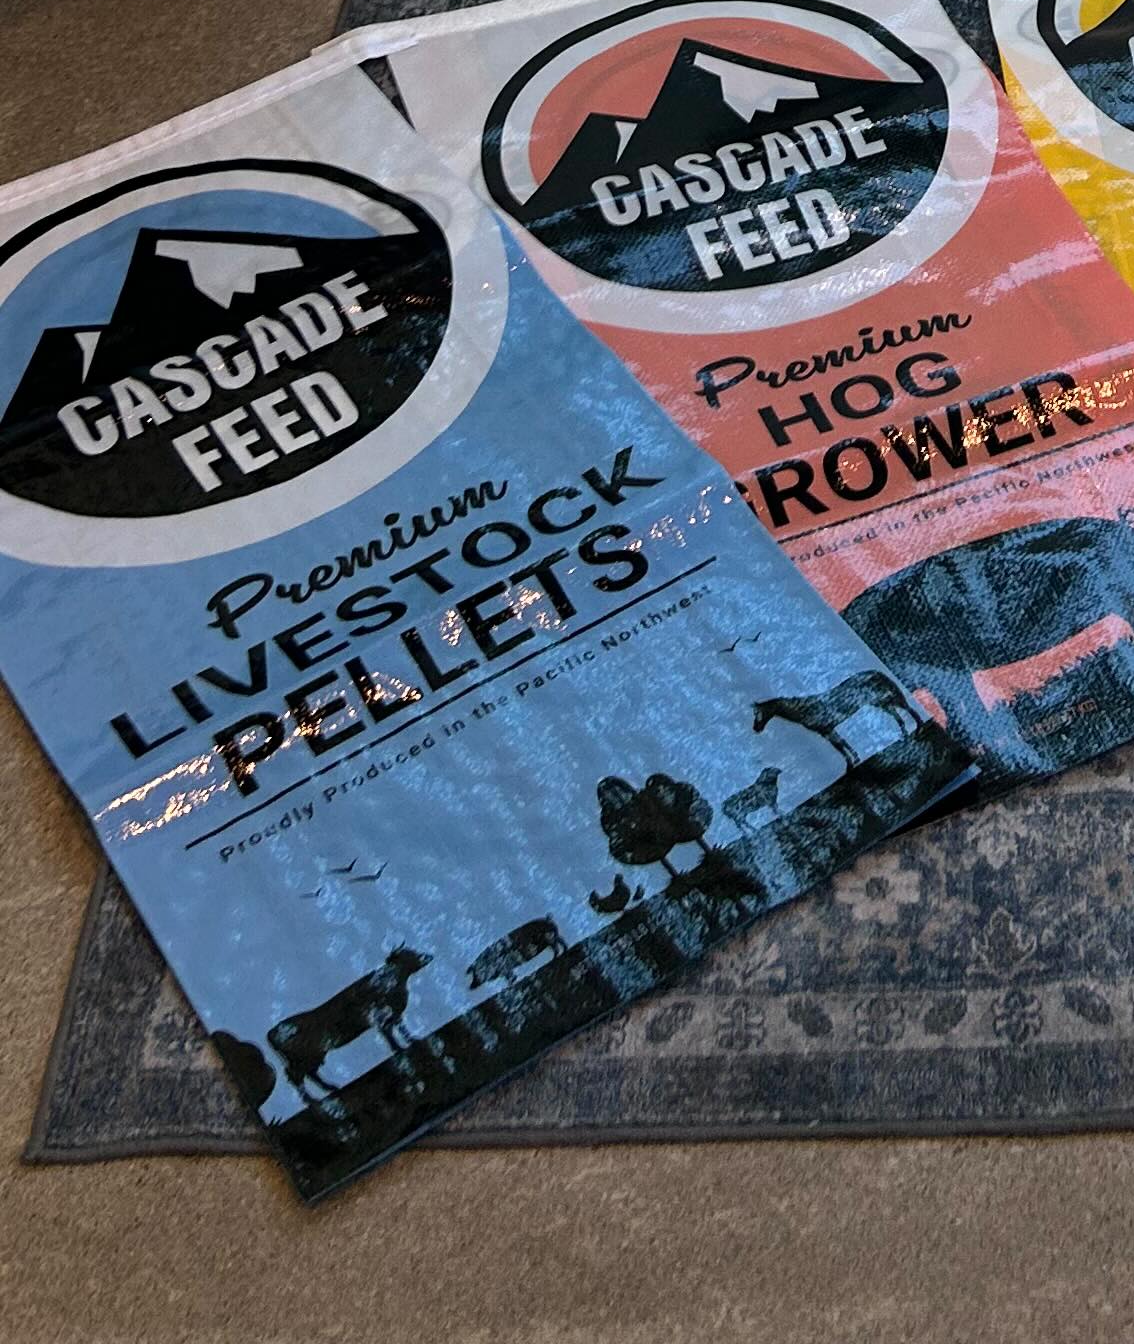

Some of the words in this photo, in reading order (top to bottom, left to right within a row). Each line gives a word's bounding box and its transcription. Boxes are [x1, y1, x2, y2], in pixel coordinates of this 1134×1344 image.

[590, 104, 886, 227] CASCADE
[685, 188, 851, 281] FEED
[56, 270, 388, 456] CASCADE
[695, 313, 972, 410] Premium
[756, 351, 963, 448] HOG
[171, 371, 361, 493] FEED
[733, 371, 1095, 528] ROWER
[205, 478, 508, 639] Premium
[790, 528, 878, 562] roduced
[955, 479, 1030, 507] Pacific
[109, 445, 666, 759] LIVESTOCK
[212, 523, 650, 798] PELLETS
[220, 800, 315, 863] Proudly
[322, 732, 435, 801] Produced
[443, 716, 466, 739] in
[472, 693, 511, 720] the
[516, 648, 596, 698] Pacific
[600, 584, 713, 652] Northwest
